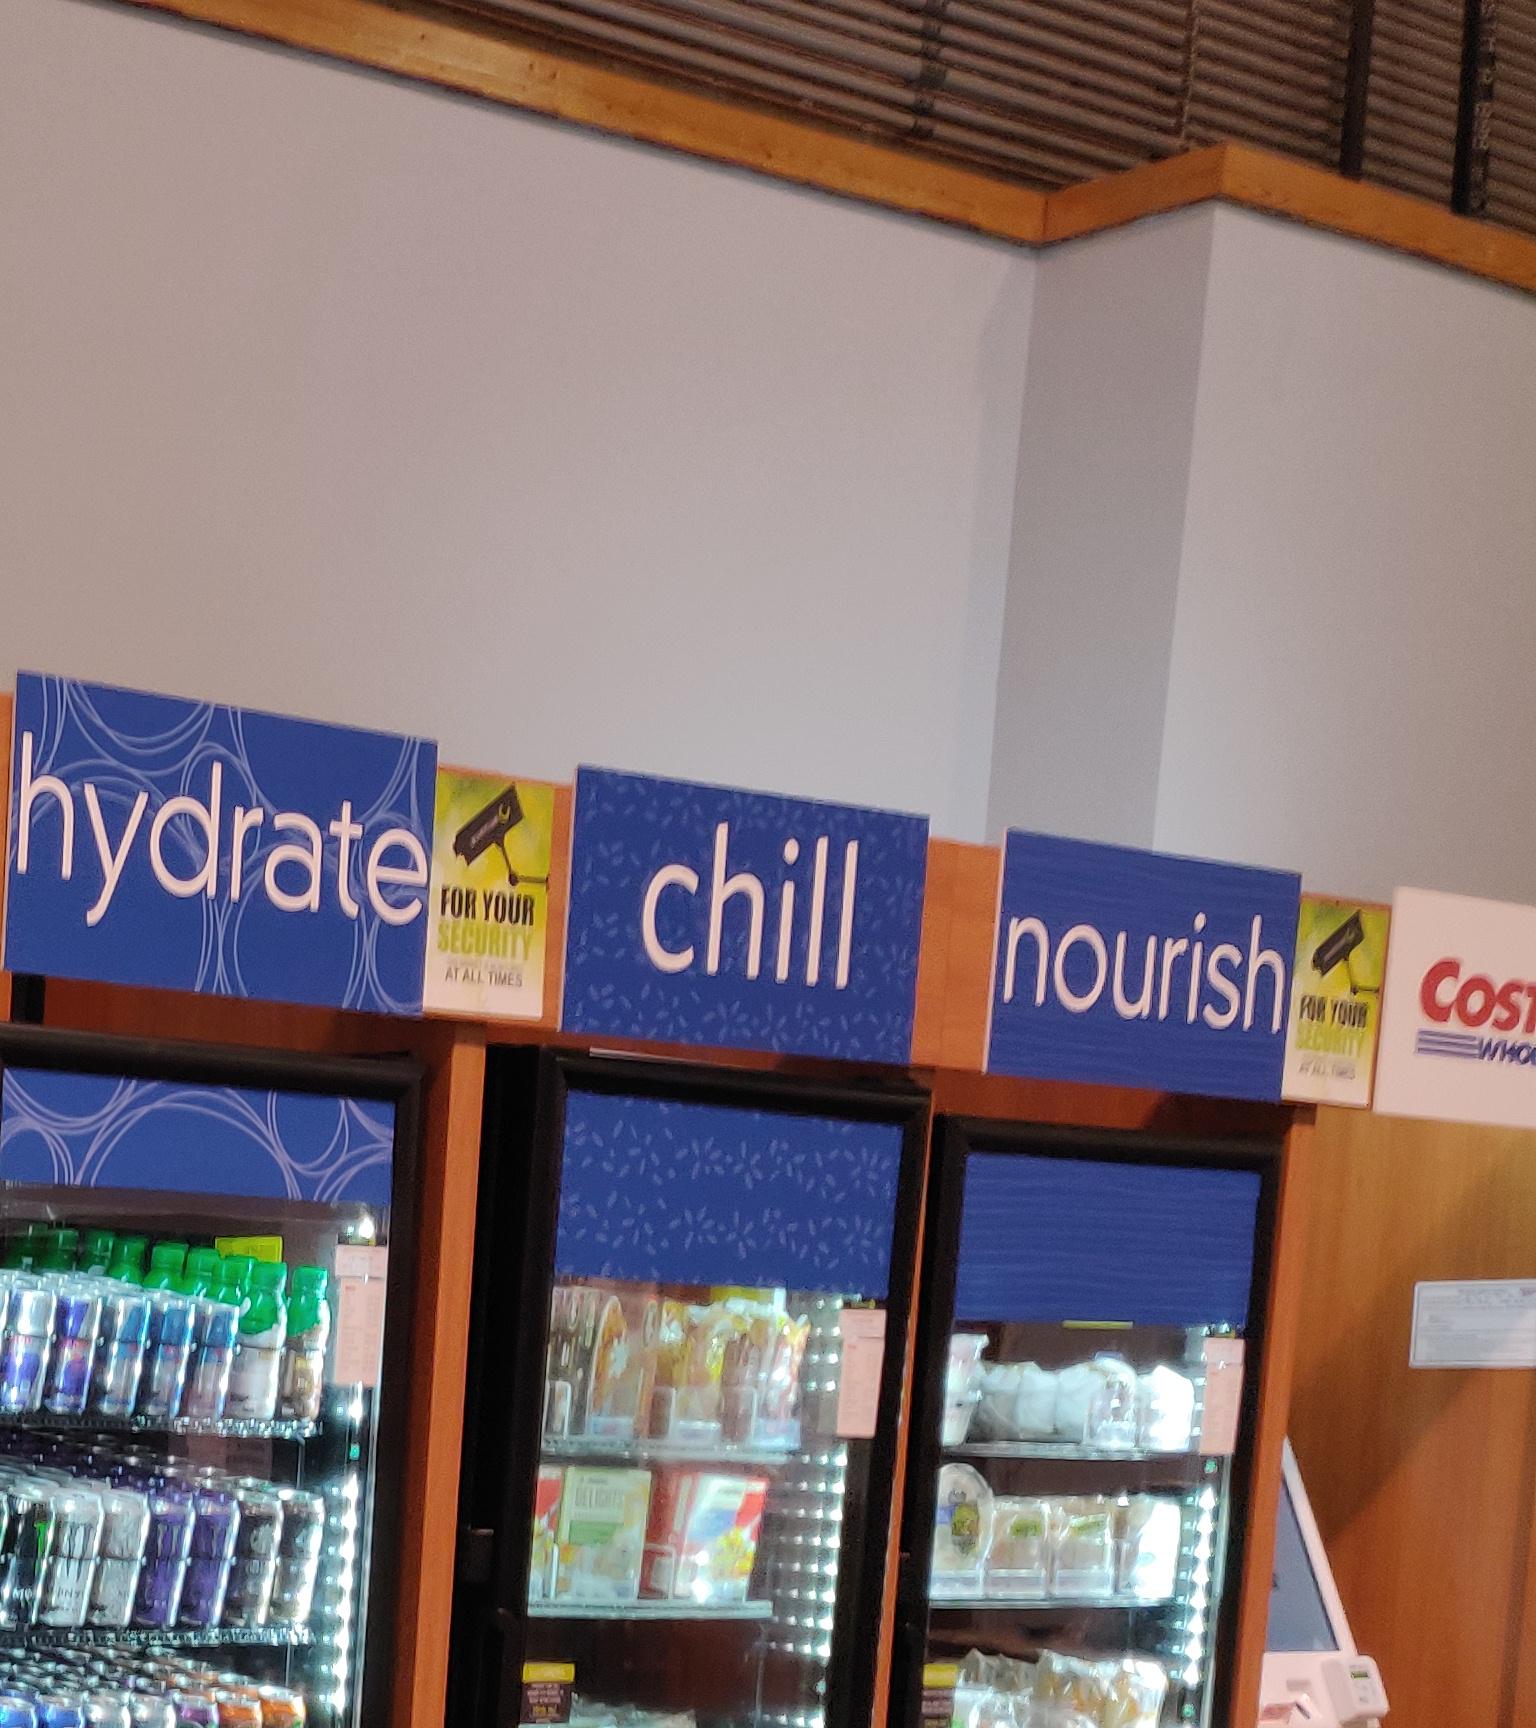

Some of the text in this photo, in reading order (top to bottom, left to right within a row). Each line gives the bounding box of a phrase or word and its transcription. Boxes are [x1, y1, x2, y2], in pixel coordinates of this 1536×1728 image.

[16, 730, 428, 927] hydrate
[436, 919, 534, 961] SECURITY
[440, 886, 535, 926] FOR YOUR
[641, 820, 859, 990] chill
[444, 966, 523, 988] AT ALL TIMES
[1002, 911, 1287, 1035] nourish
